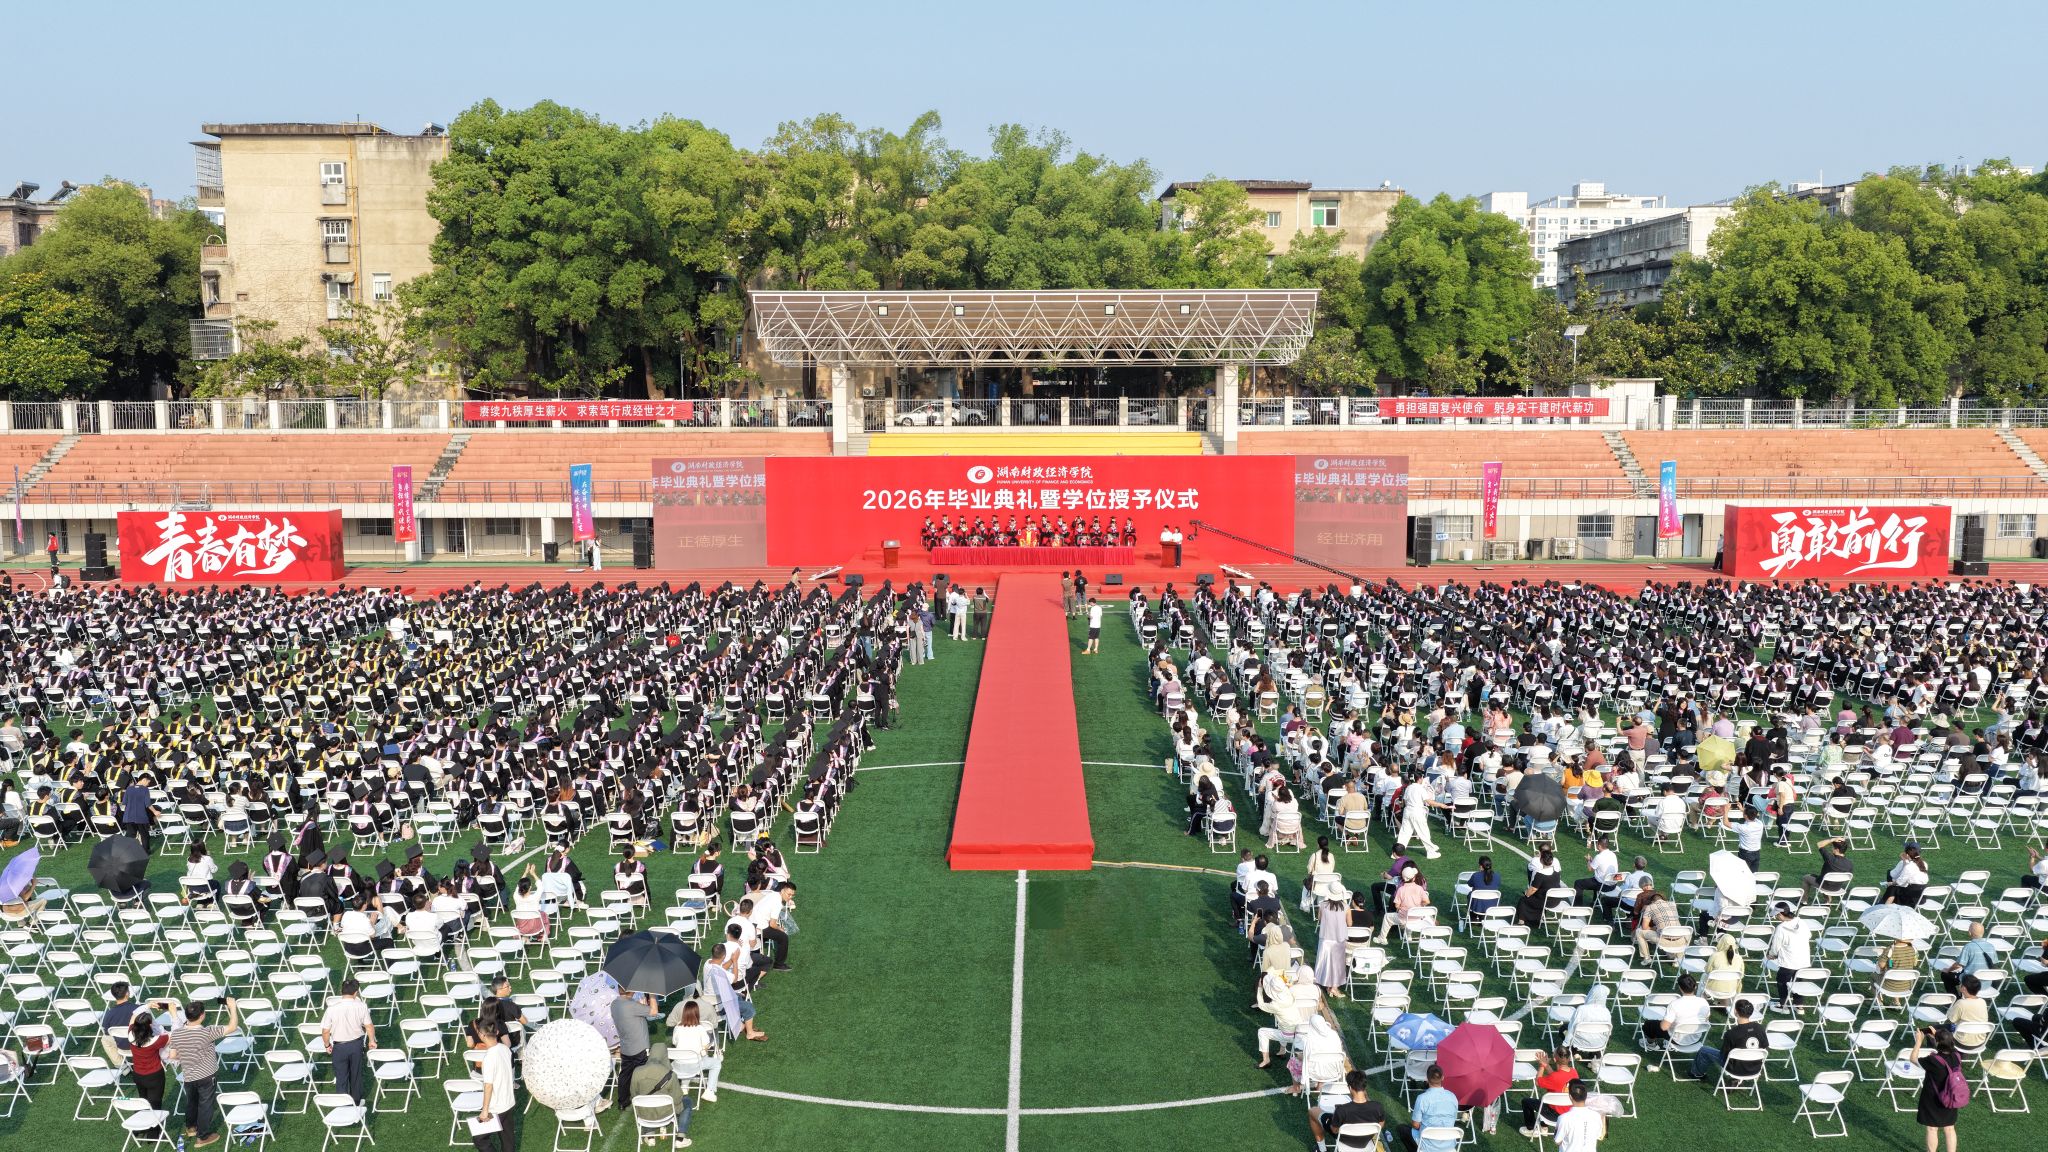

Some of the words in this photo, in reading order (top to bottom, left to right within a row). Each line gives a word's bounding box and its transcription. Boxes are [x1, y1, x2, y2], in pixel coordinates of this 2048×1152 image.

[479, 404, 568, 417] 赓续九秩厚生薪火
[577, 404, 677, 417] 求索笃行成经世之才
[1395, 401, 1485, 414] 勇担强国复兴使命
[1493, 401, 1594, 414] 躬身实干建时代新功
[996, 466, 1094, 479] 湖南财政经济学院
[862, 488, 1199, 510] 2026年毕业典礼暨学位授予仪式
[677, 534, 744, 548] 正德厚生
[1317, 533, 1383, 545] 经世济用
[1759, 506, 1928, 577] 勇敢前行
[141, 512, 308, 582] 青春有梦
